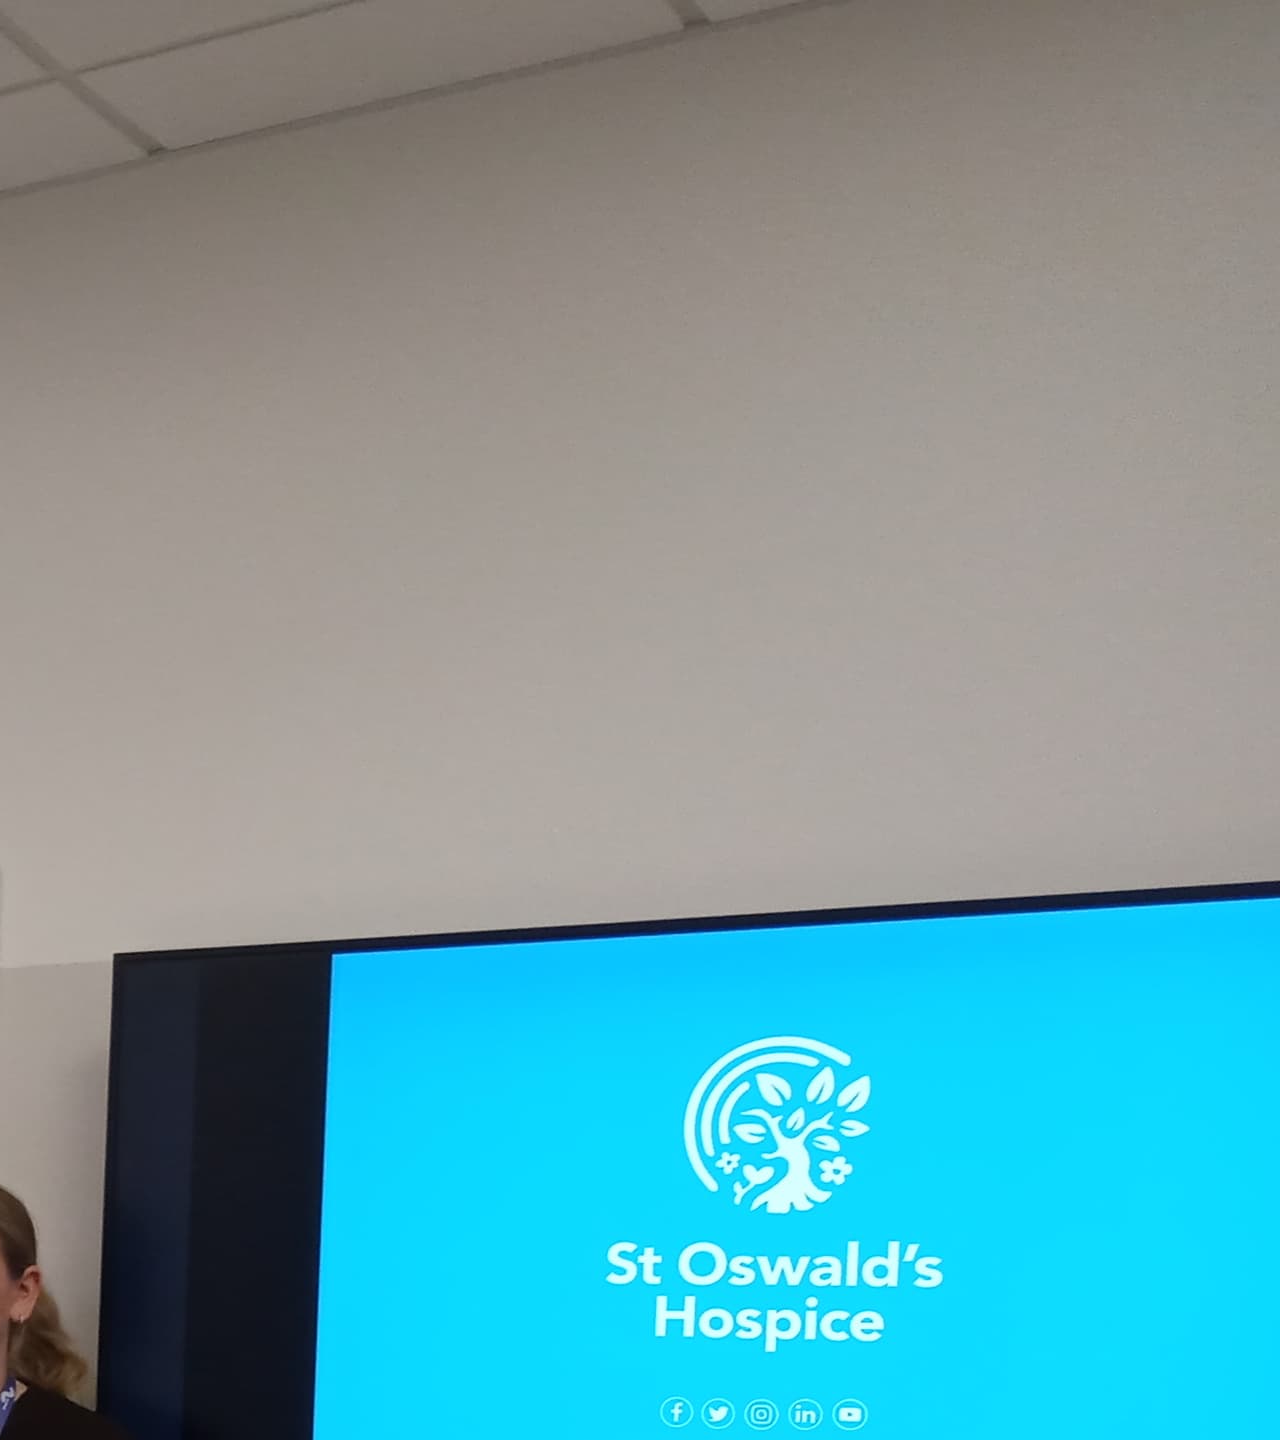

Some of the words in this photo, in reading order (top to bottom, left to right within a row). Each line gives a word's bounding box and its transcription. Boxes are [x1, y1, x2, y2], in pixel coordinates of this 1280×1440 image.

[605, 1241, 663, 1285] St
[678, 1241, 944, 1288] Oswald's
[654, 1295, 885, 1353] Hospice
